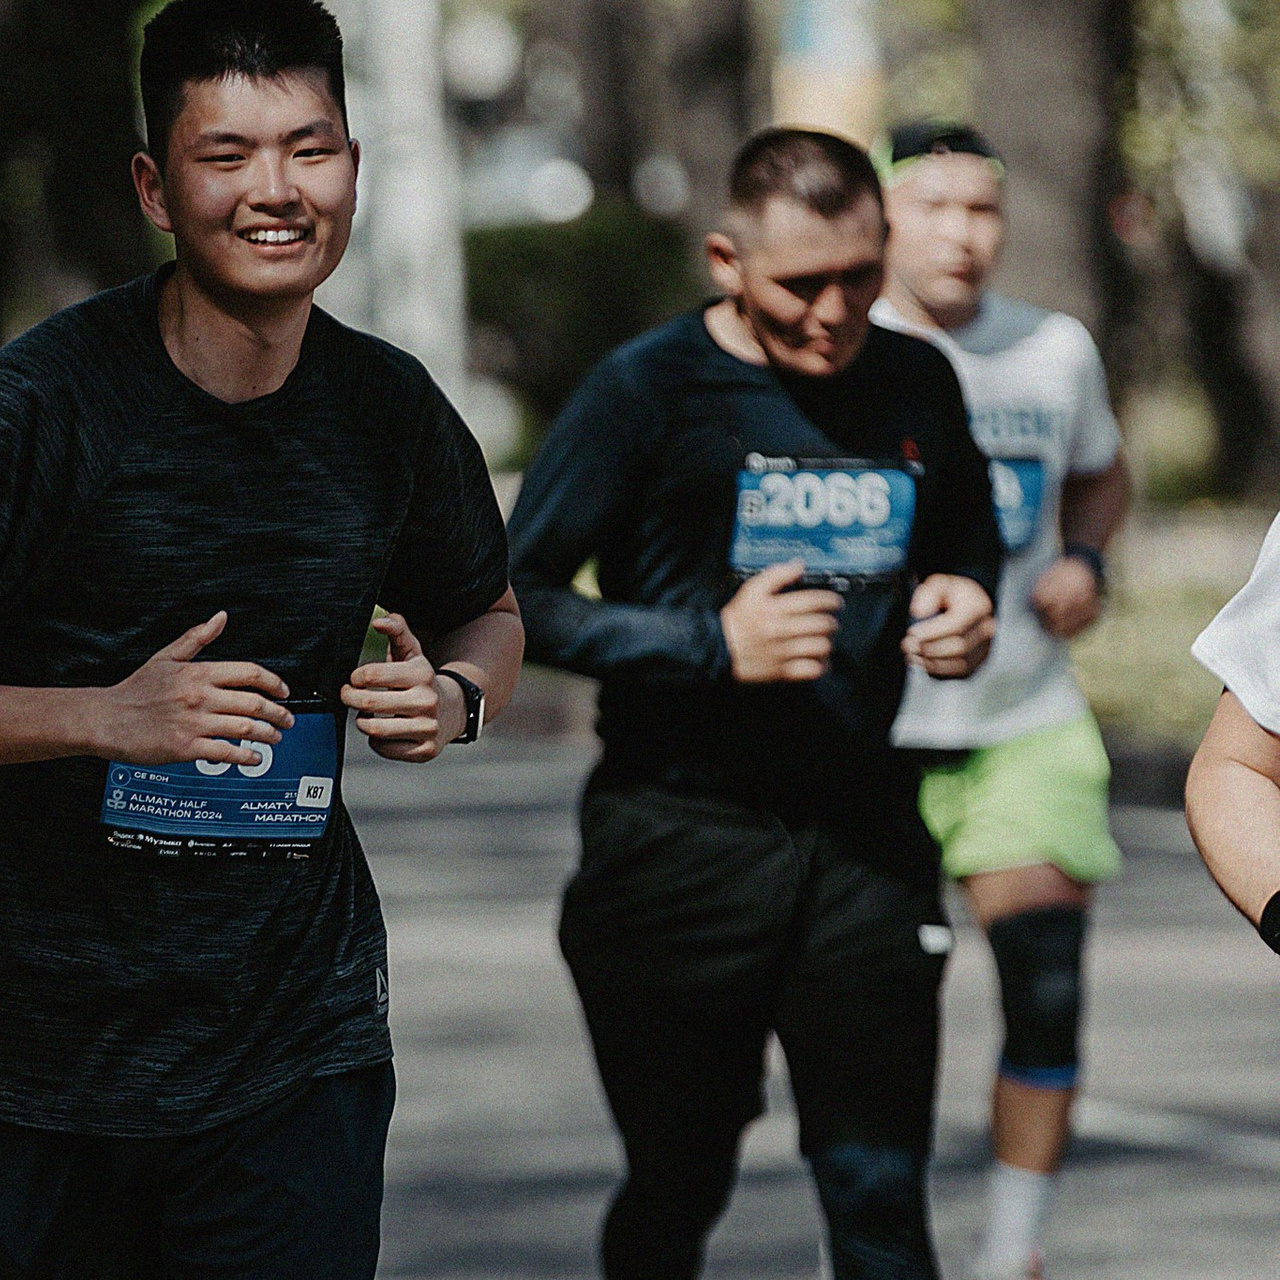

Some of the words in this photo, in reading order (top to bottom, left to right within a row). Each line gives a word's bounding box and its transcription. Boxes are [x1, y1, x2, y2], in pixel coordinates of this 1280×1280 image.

[759, 472, 892, 528] 2066
[306, 785, 325, 800] K87
[130, 793, 178, 808] ALMATY
[179, 800, 208, 809] HALF
[241, 802, 294, 810] ALMATY
[128, 803, 192, 818] MARATHON
[194, 811, 223, 820] 2024
[254, 814, 327, 822] MARATHON
[144, 835, 182, 846] Музыка
